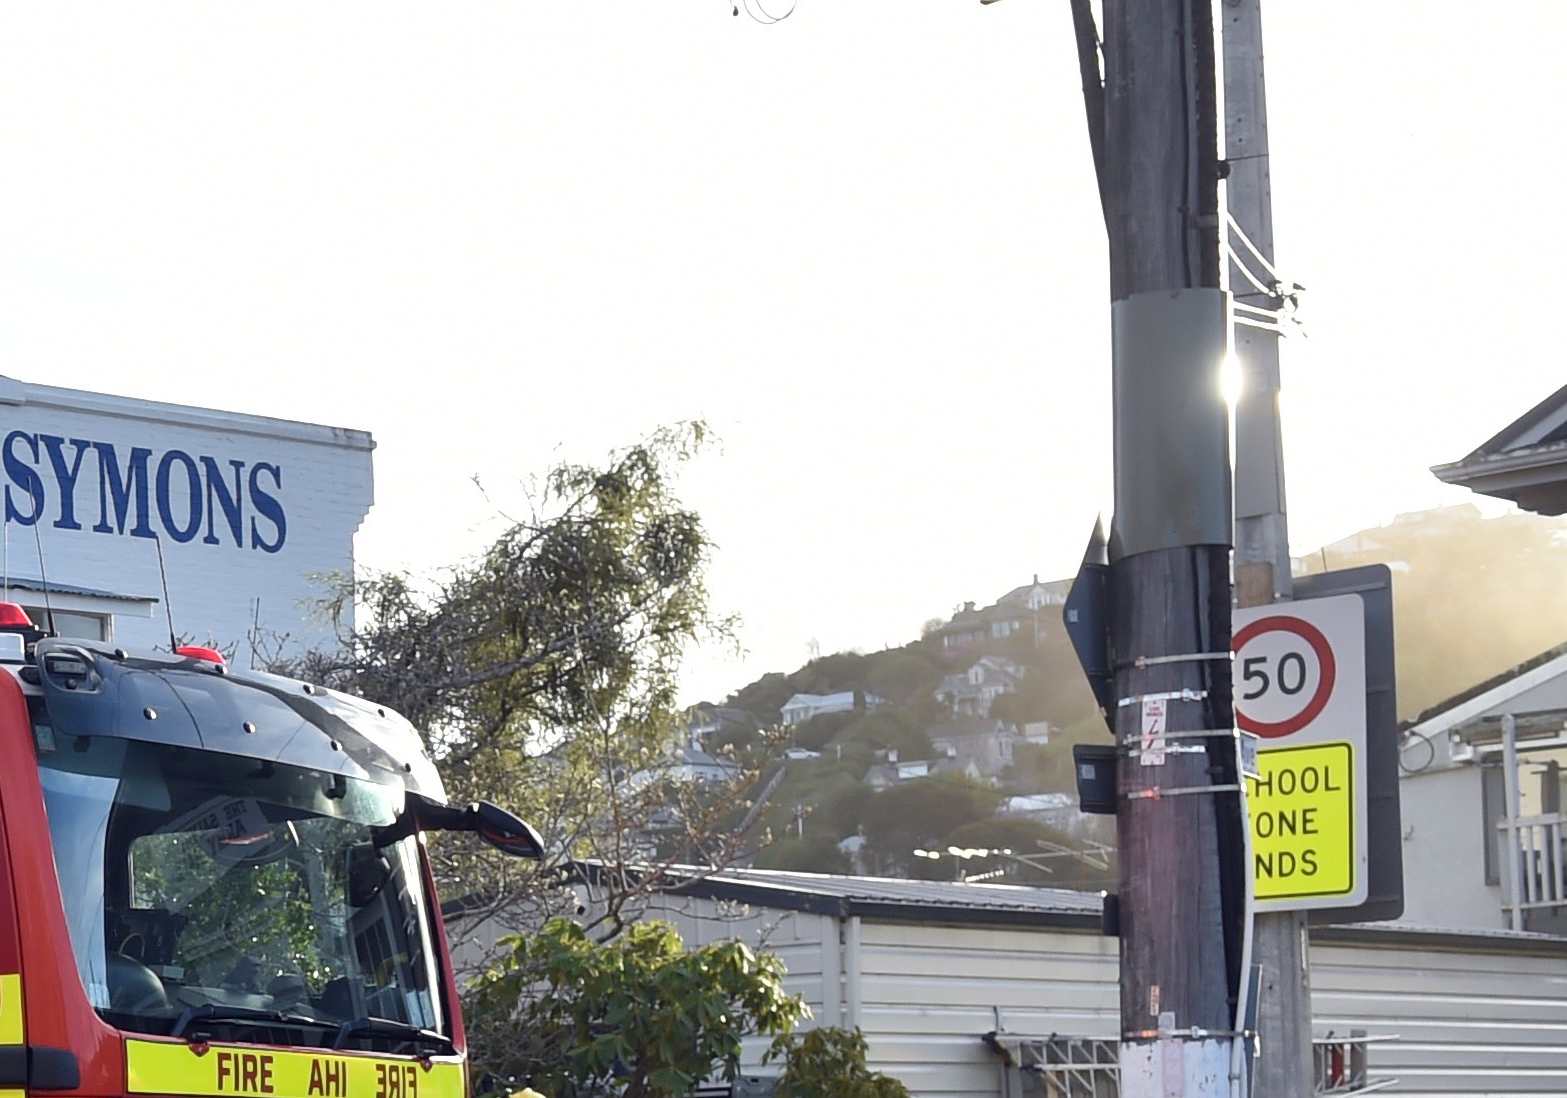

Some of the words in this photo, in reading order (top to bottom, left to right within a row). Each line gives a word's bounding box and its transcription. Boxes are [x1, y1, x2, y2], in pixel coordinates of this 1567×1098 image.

[1, 430, 289, 555] SYMONS
[1243, 652, 1307, 700] 50
[1255, 764, 1341, 798] HOOL
[1255, 807, 1319, 839] ONE
[1255, 849, 1318, 880] NDS
[217, 1051, 275, 1094] FIRE
[307, 1058, 347, 1098] AHI
